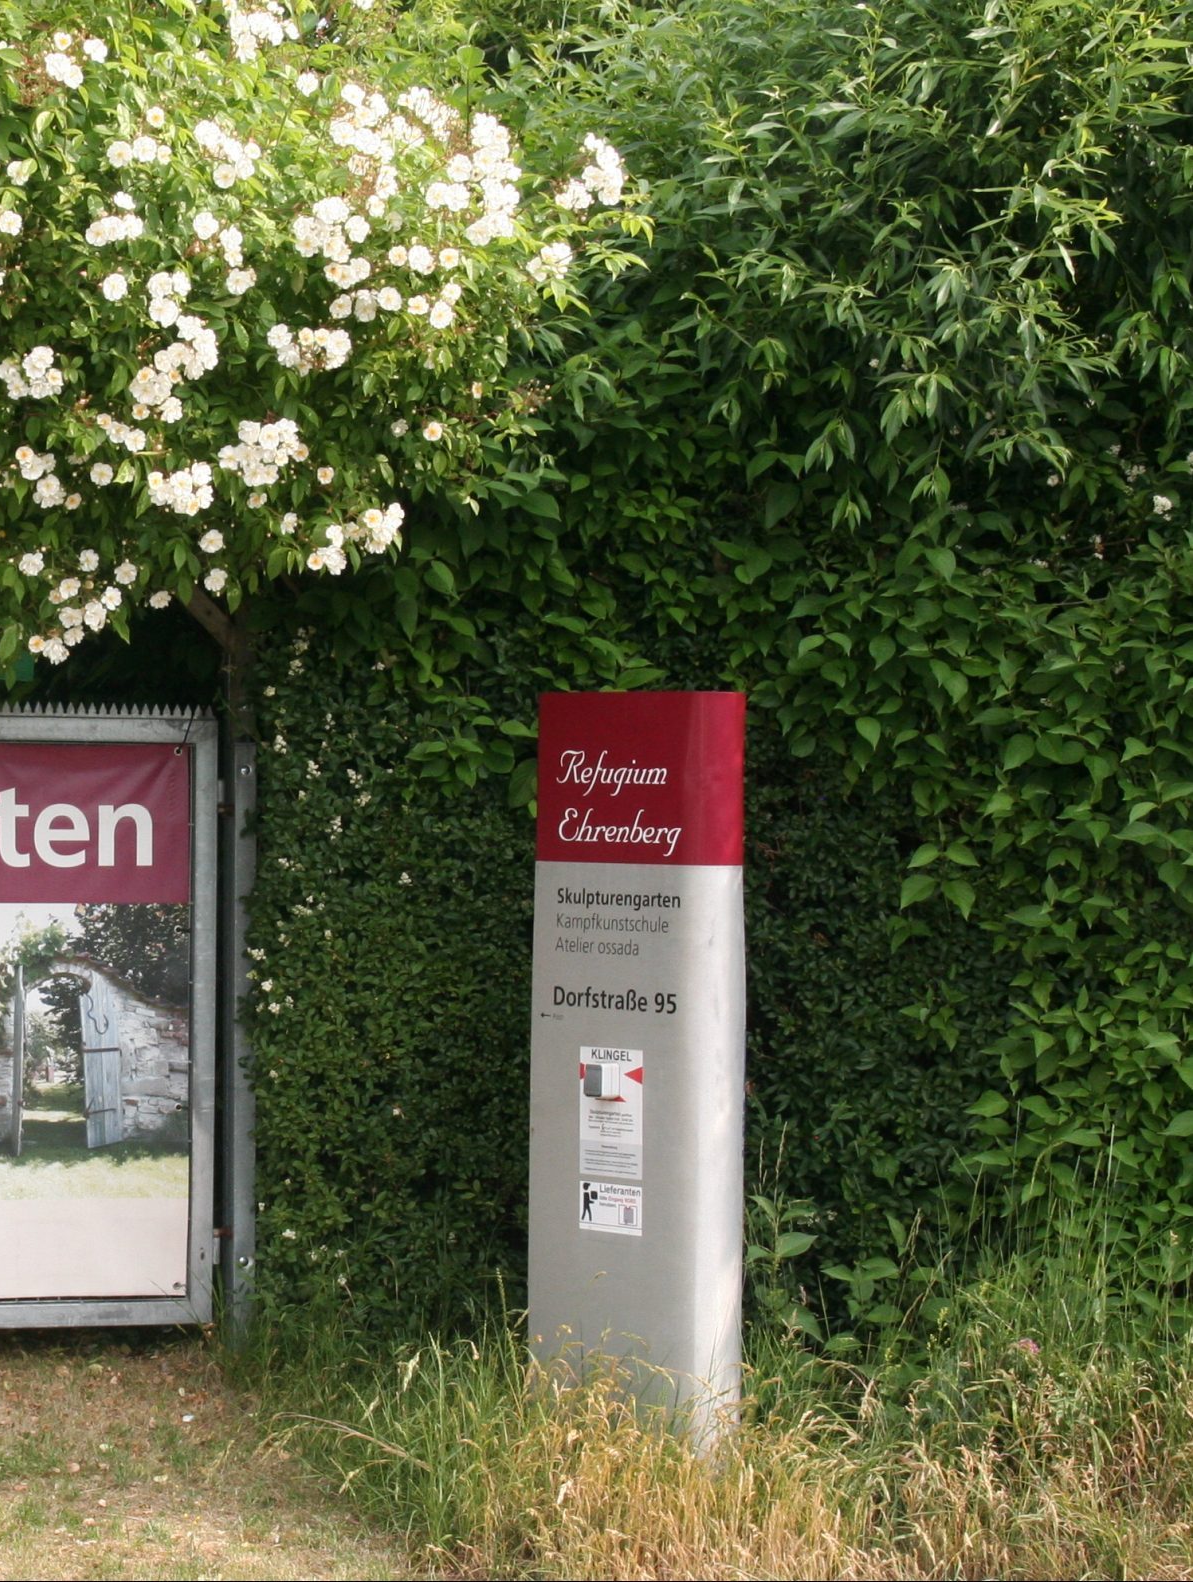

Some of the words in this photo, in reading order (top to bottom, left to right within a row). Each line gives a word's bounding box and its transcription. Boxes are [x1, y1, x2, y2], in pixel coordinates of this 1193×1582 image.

[556, 749, 668, 797] Refugium
[558, 807, 682, 857] Ehrenberg
[557, 888, 681, 911] Skulpturengarten
[556, 913, 670, 934] Kampfkunstschule
[555, 936, 594, 955] Atelier
[597, 938, 639, 956] ossada
[553, 985, 648, 1013] Dorfstraße
[654, 993, 678, 1015] 95
[591, 1048, 632, 1062] KLINGEL
[599, 1184, 641, 1197] Lieferanten
